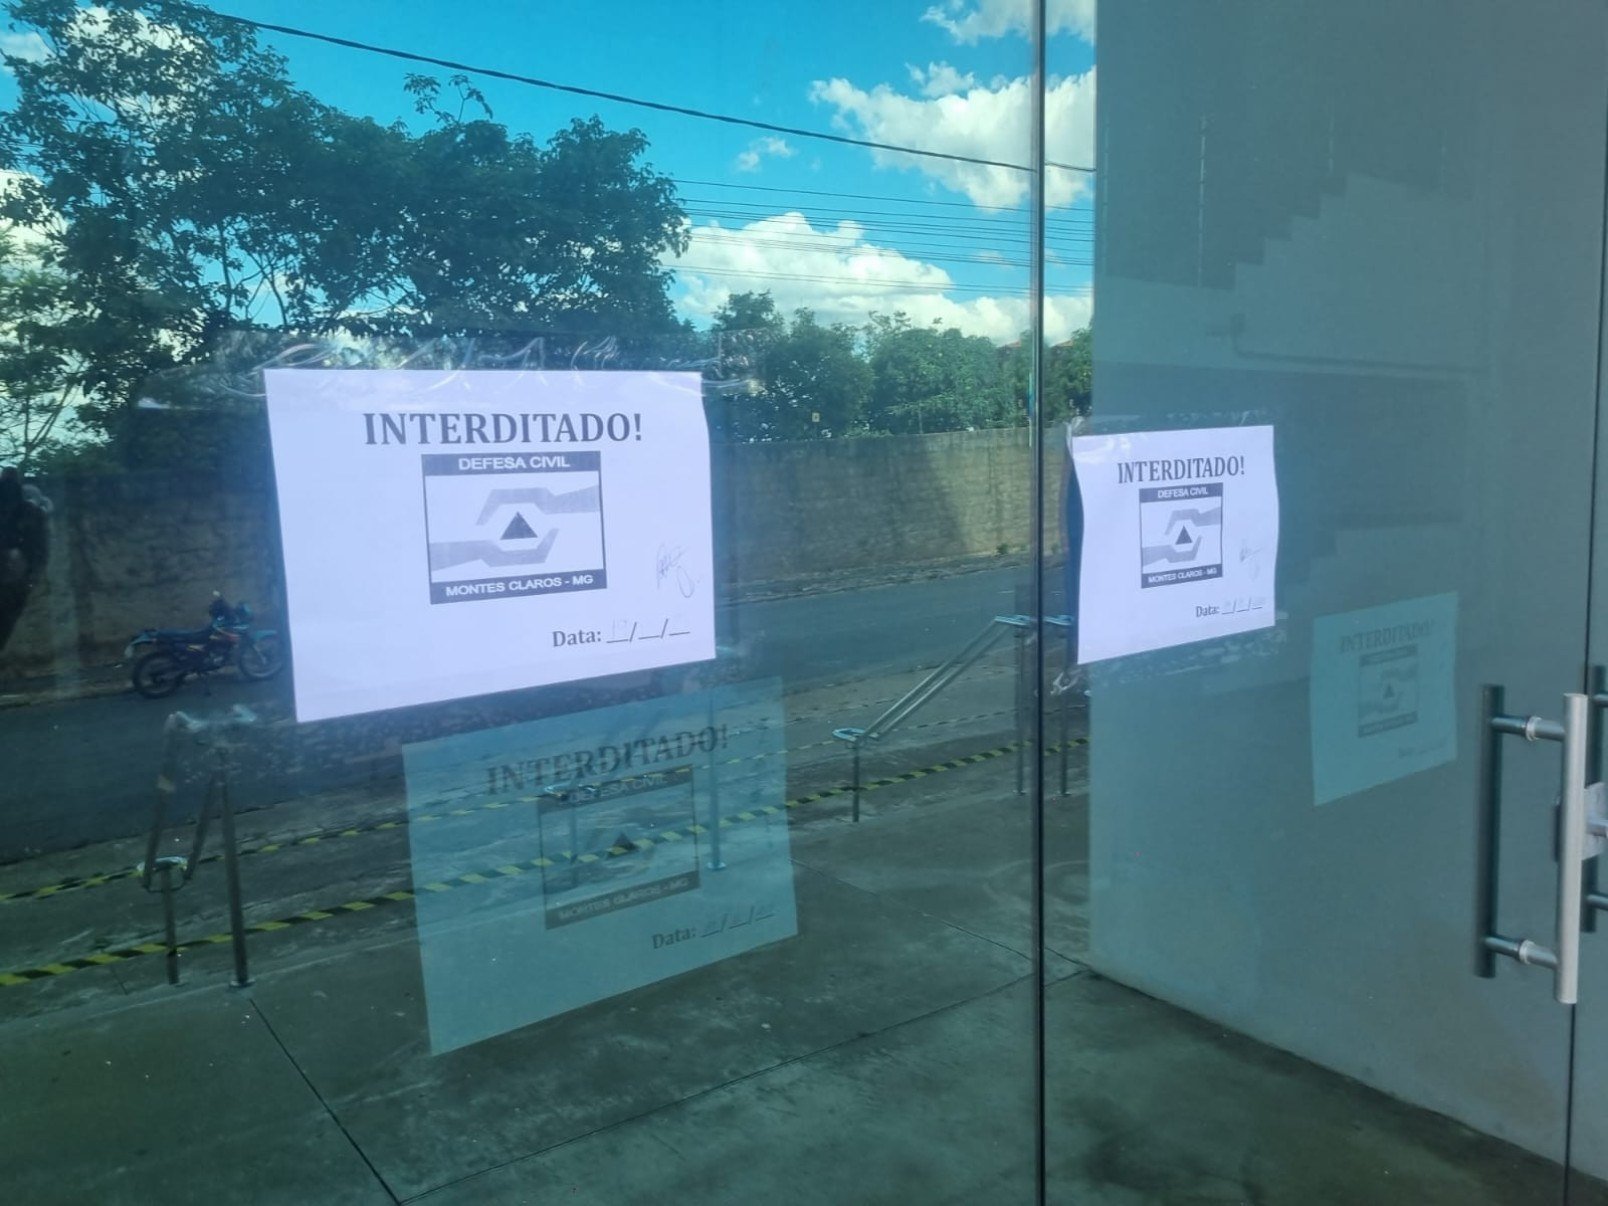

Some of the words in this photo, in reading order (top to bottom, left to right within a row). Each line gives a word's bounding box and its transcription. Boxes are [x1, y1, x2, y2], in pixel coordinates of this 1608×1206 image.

[363, 412, 643, 445] INTERDITADO!
[458, 457, 526, 471] DEFESA
[530, 455, 571, 469] CIVIL
[1117, 456, 1245, 484] INTERDITADO!
[1157, 488, 1190, 499] DEFESA
[1190, 486, 1208, 497] CIVIL
[445, 581, 506, 597] MONTES
[508, 577, 563, 592] CLAROS
[572, 574, 594, 587] MG
[552, 628, 602, 648] Data:
[487, 724, 729, 796] INTERDITADO!
[569, 781, 630, 803] DEESA
[652, 924, 697, 950] Data:
